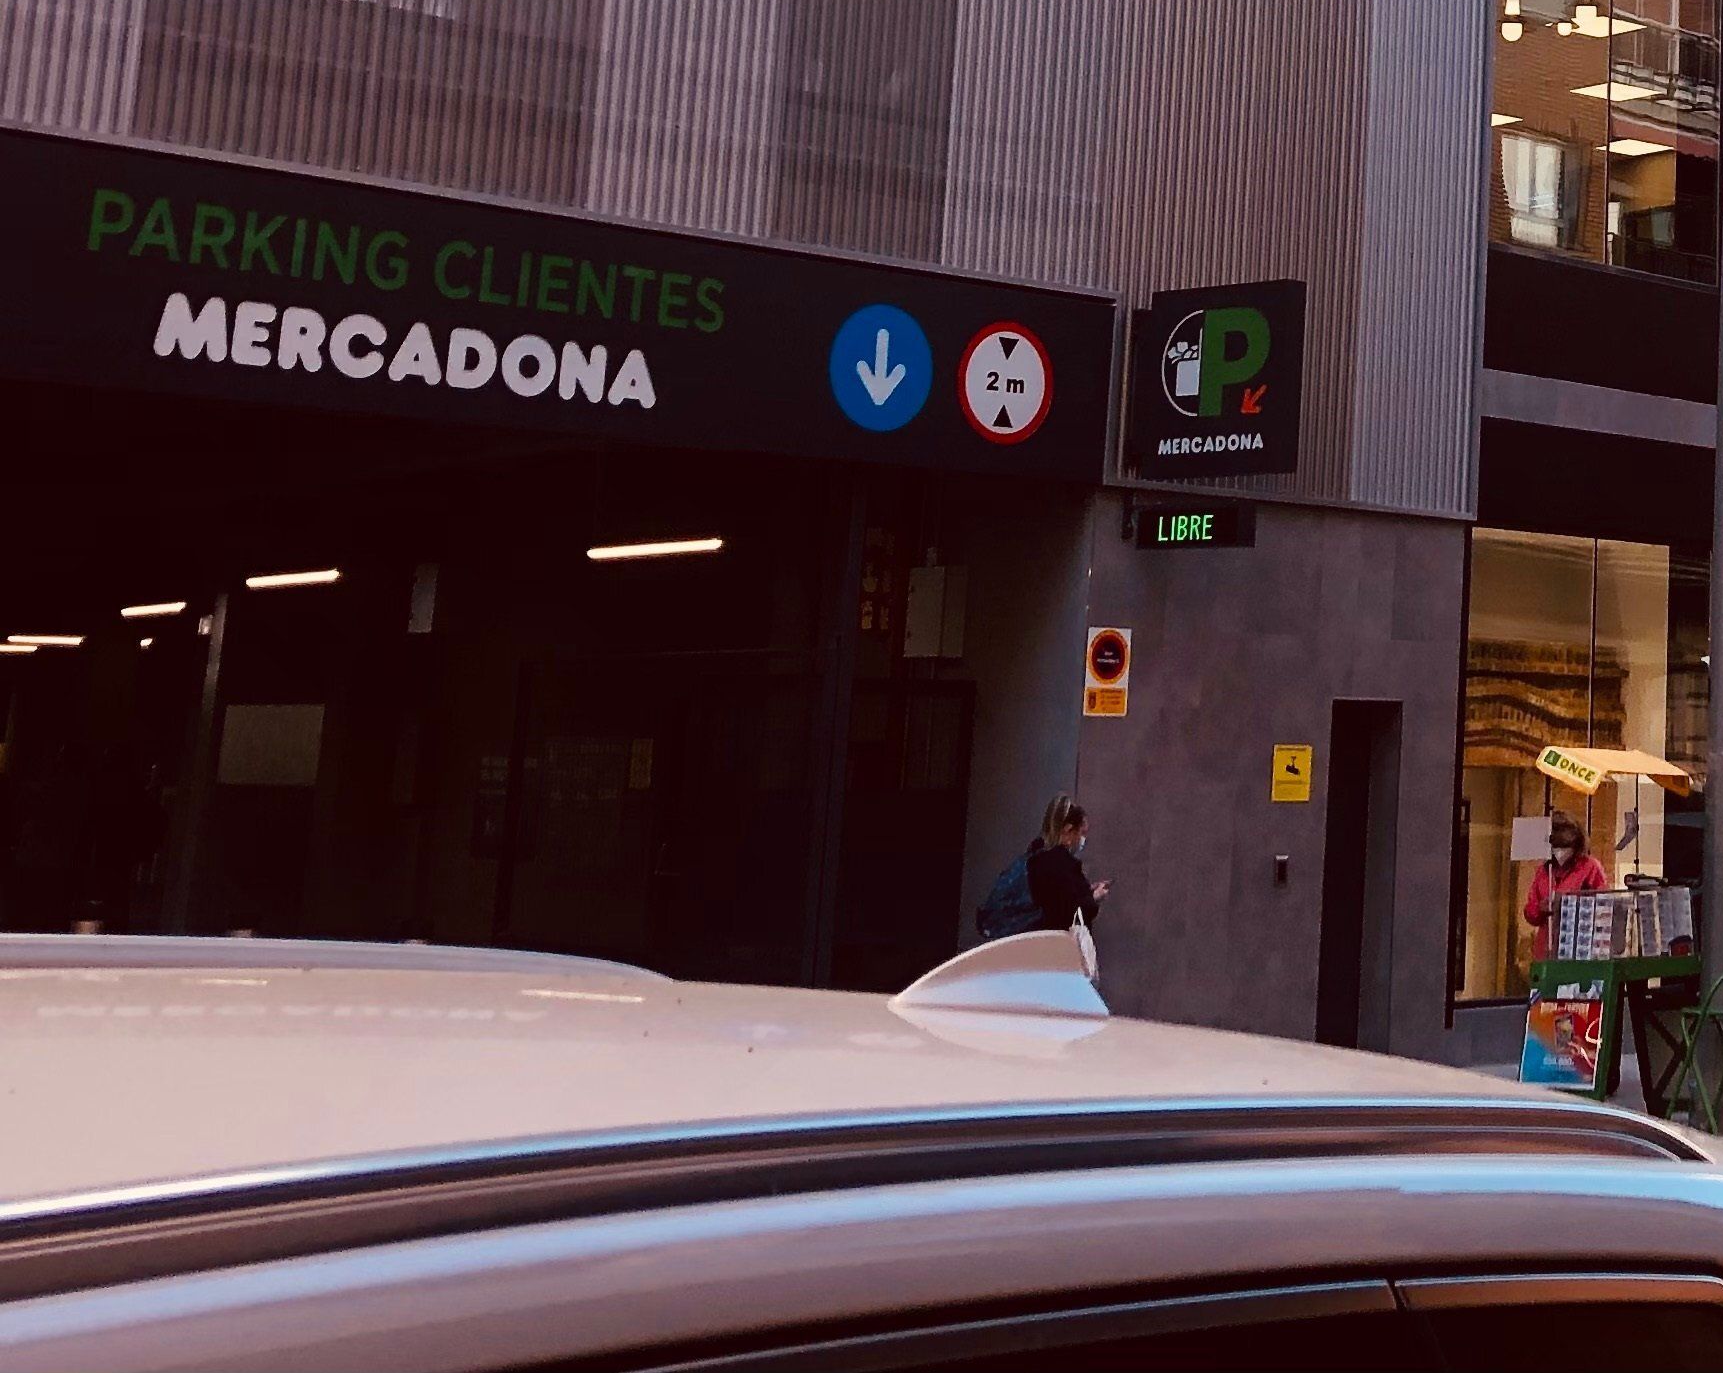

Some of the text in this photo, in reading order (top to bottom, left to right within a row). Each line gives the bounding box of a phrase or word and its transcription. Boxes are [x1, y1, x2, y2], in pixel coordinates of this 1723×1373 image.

[87, 188, 726, 333] PARKING CLIENTES
[153, 291, 657, 409] MERCADONA
[1199, 307, 1271, 417] P
[986, 371, 1025, 394] 2 m
[1157, 433, 1263, 455] MERCADONA
[1157, 514, 1214, 542] LIBRE
[1559, 760, 1596, 784] ONCE
